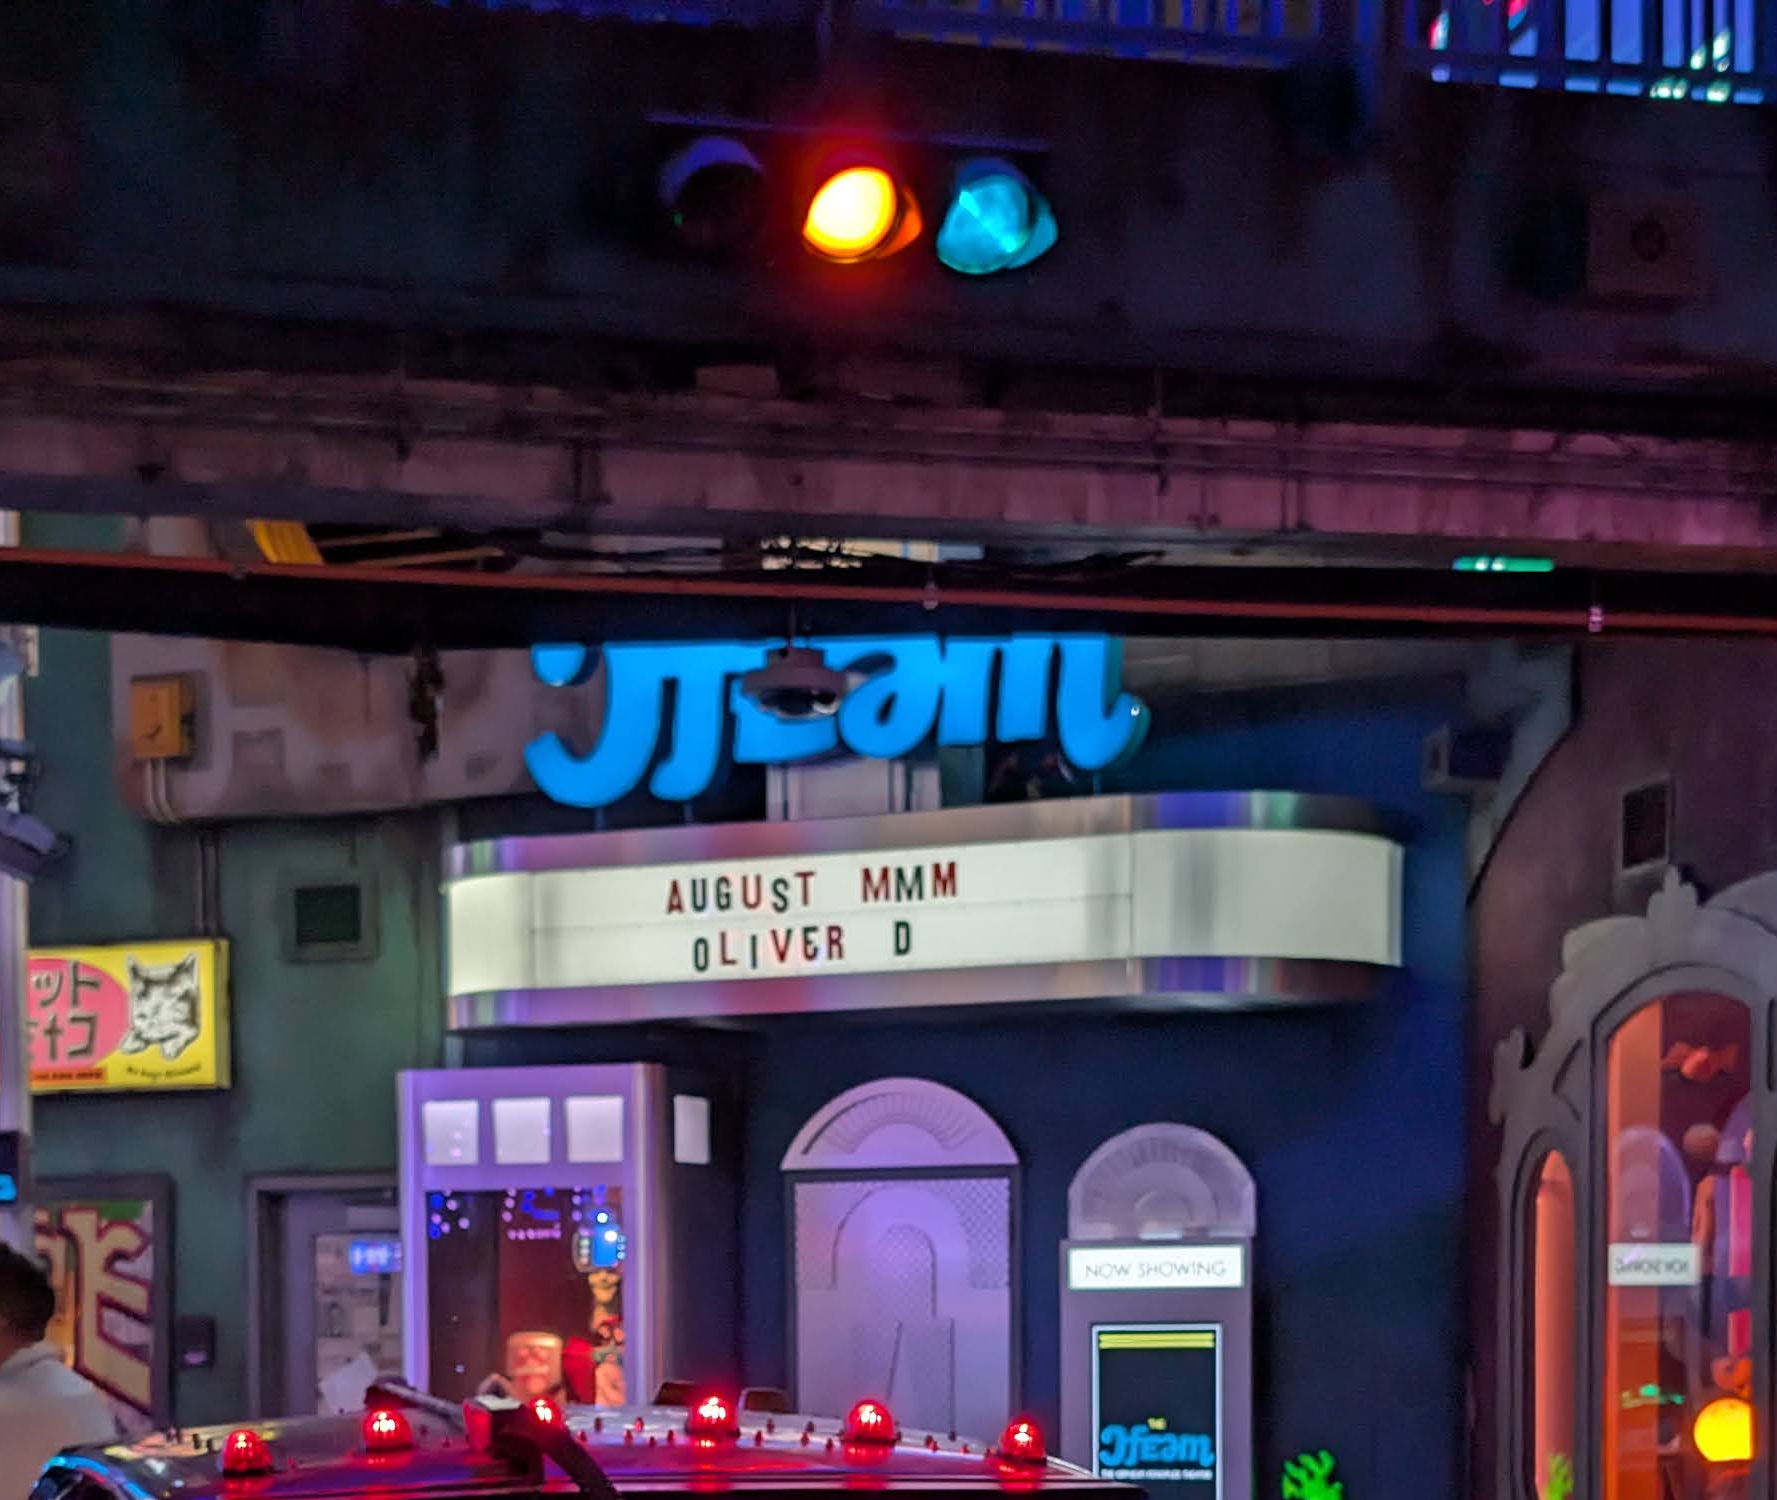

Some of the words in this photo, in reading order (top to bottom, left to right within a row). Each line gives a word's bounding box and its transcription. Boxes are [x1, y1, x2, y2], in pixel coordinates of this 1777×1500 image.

[665, 870, 816, 915] AUGUST
[860, 861, 957, 903] MMM
[692, 924, 845, 973] OLIVER
[893, 920, 913, 957] D
[1084, 1262, 1130, 1280] NOW
[1136, 1259, 1228, 1279] SHOWING
